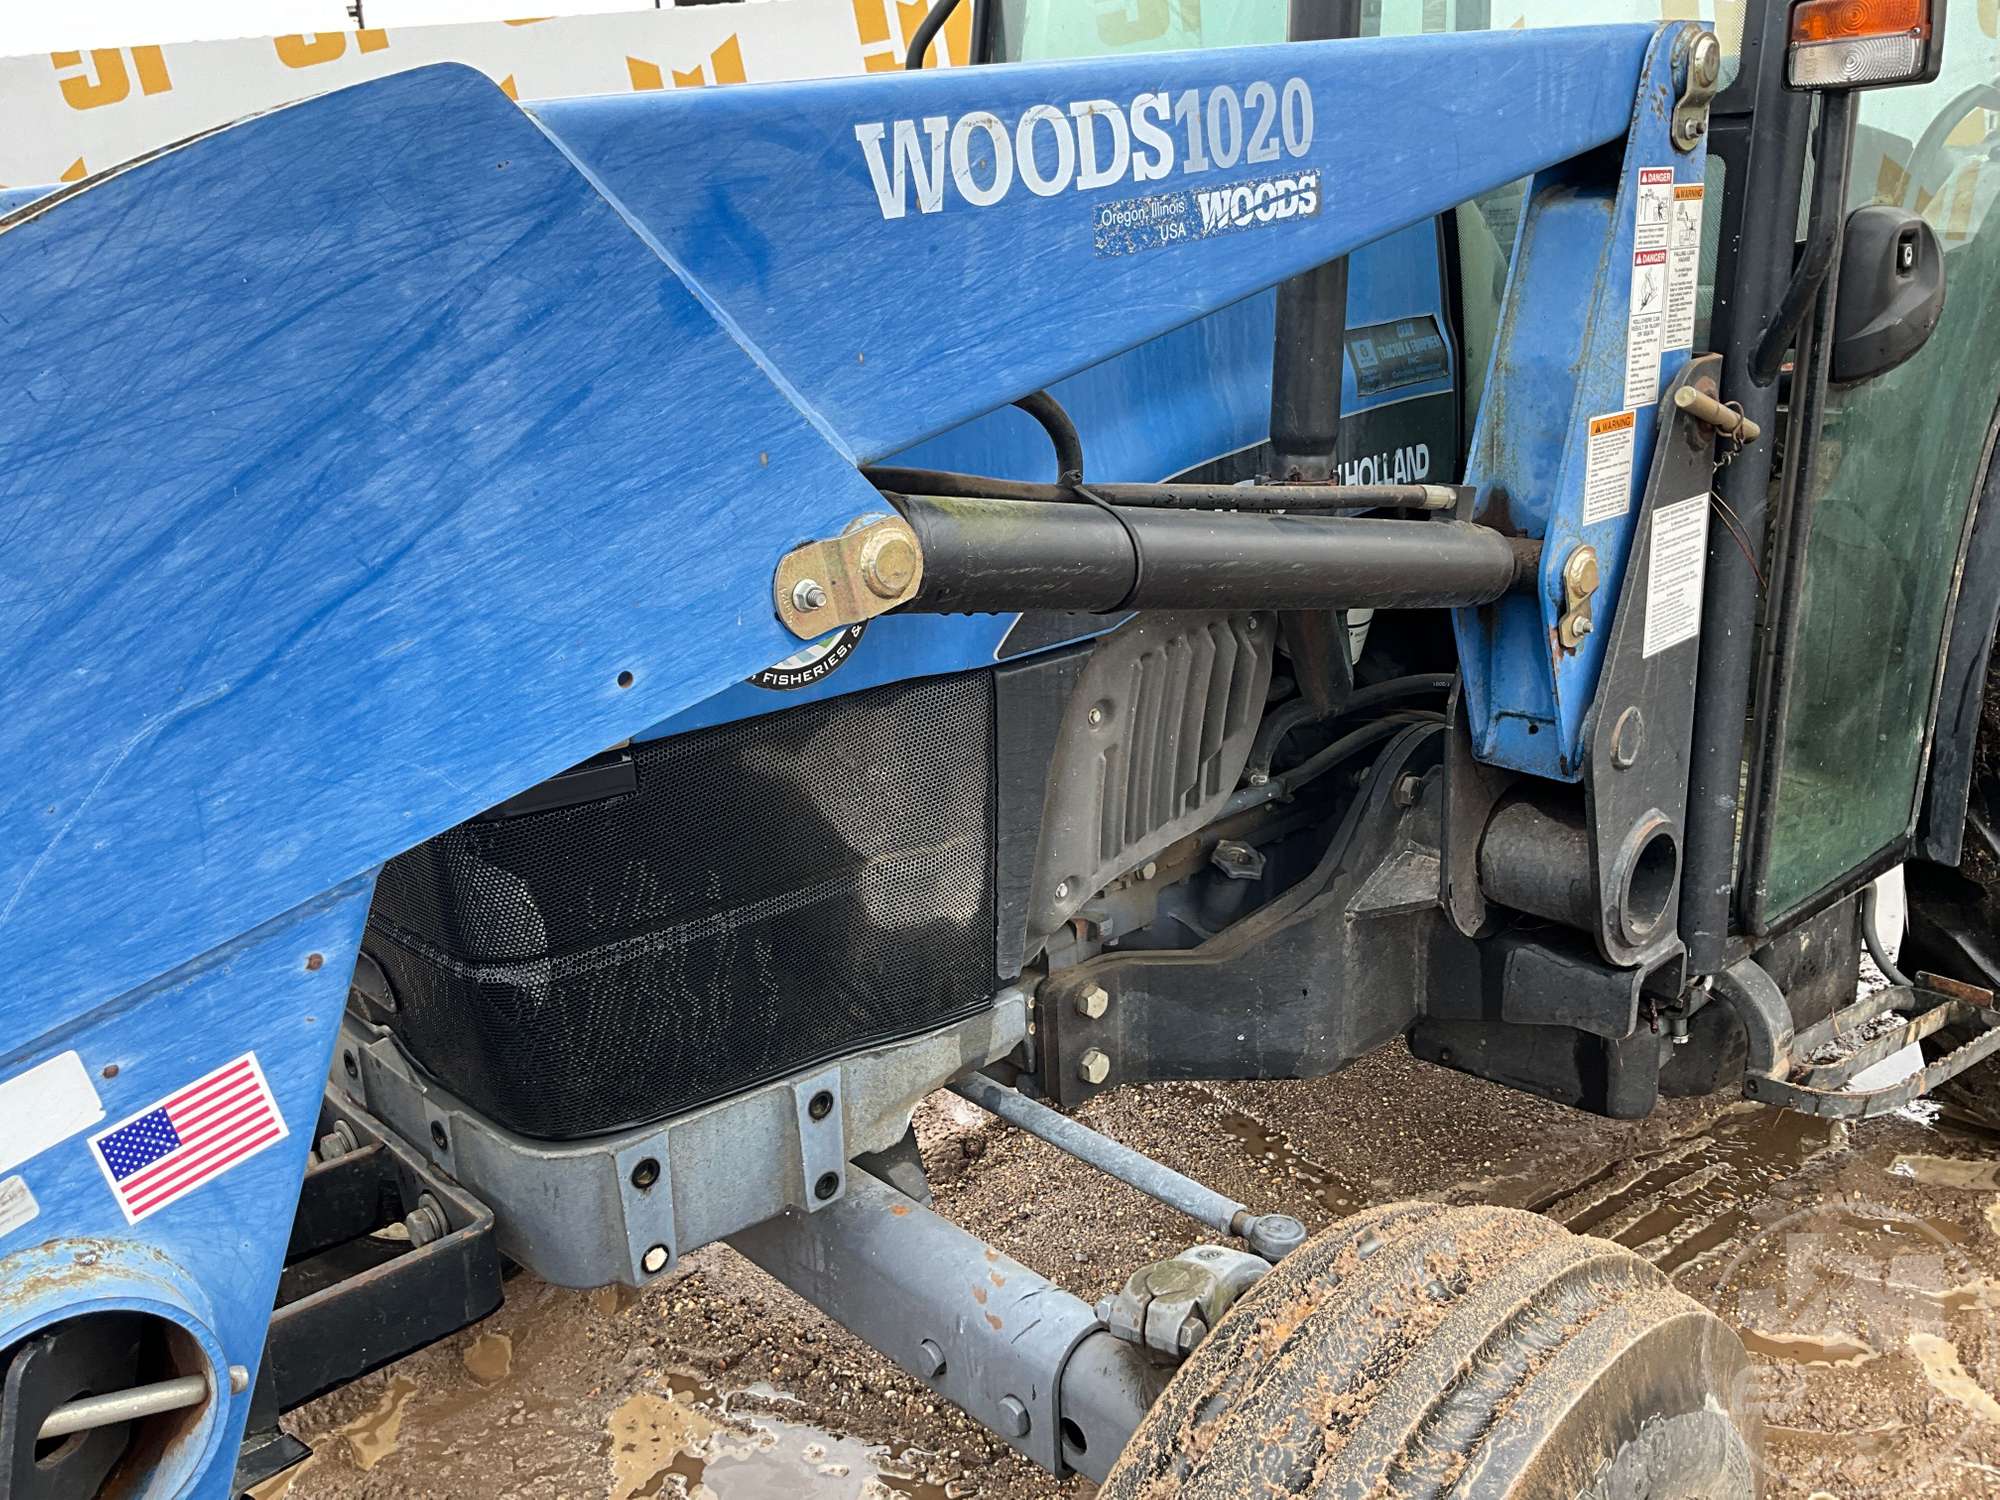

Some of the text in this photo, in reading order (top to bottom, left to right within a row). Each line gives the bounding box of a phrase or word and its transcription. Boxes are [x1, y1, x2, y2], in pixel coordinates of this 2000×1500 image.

[855, 77, 1315, 220] WOODS 1020
[1647, 172, 1671, 183] DANGER
[1680, 188, 1703, 199] WARNING
[1101, 200, 1185, 227] Oregon, Illinois
[1197, 174, 1317, 238] WOODS
[1160, 222, 1187, 241] USA
[1642, 251, 1665, 264] DANGER
[1602, 416, 1631, 432] WARNING
[1344, 443, 1429, 487] HOLLAND
[762, 624, 863, 686] FISHERIES, &
